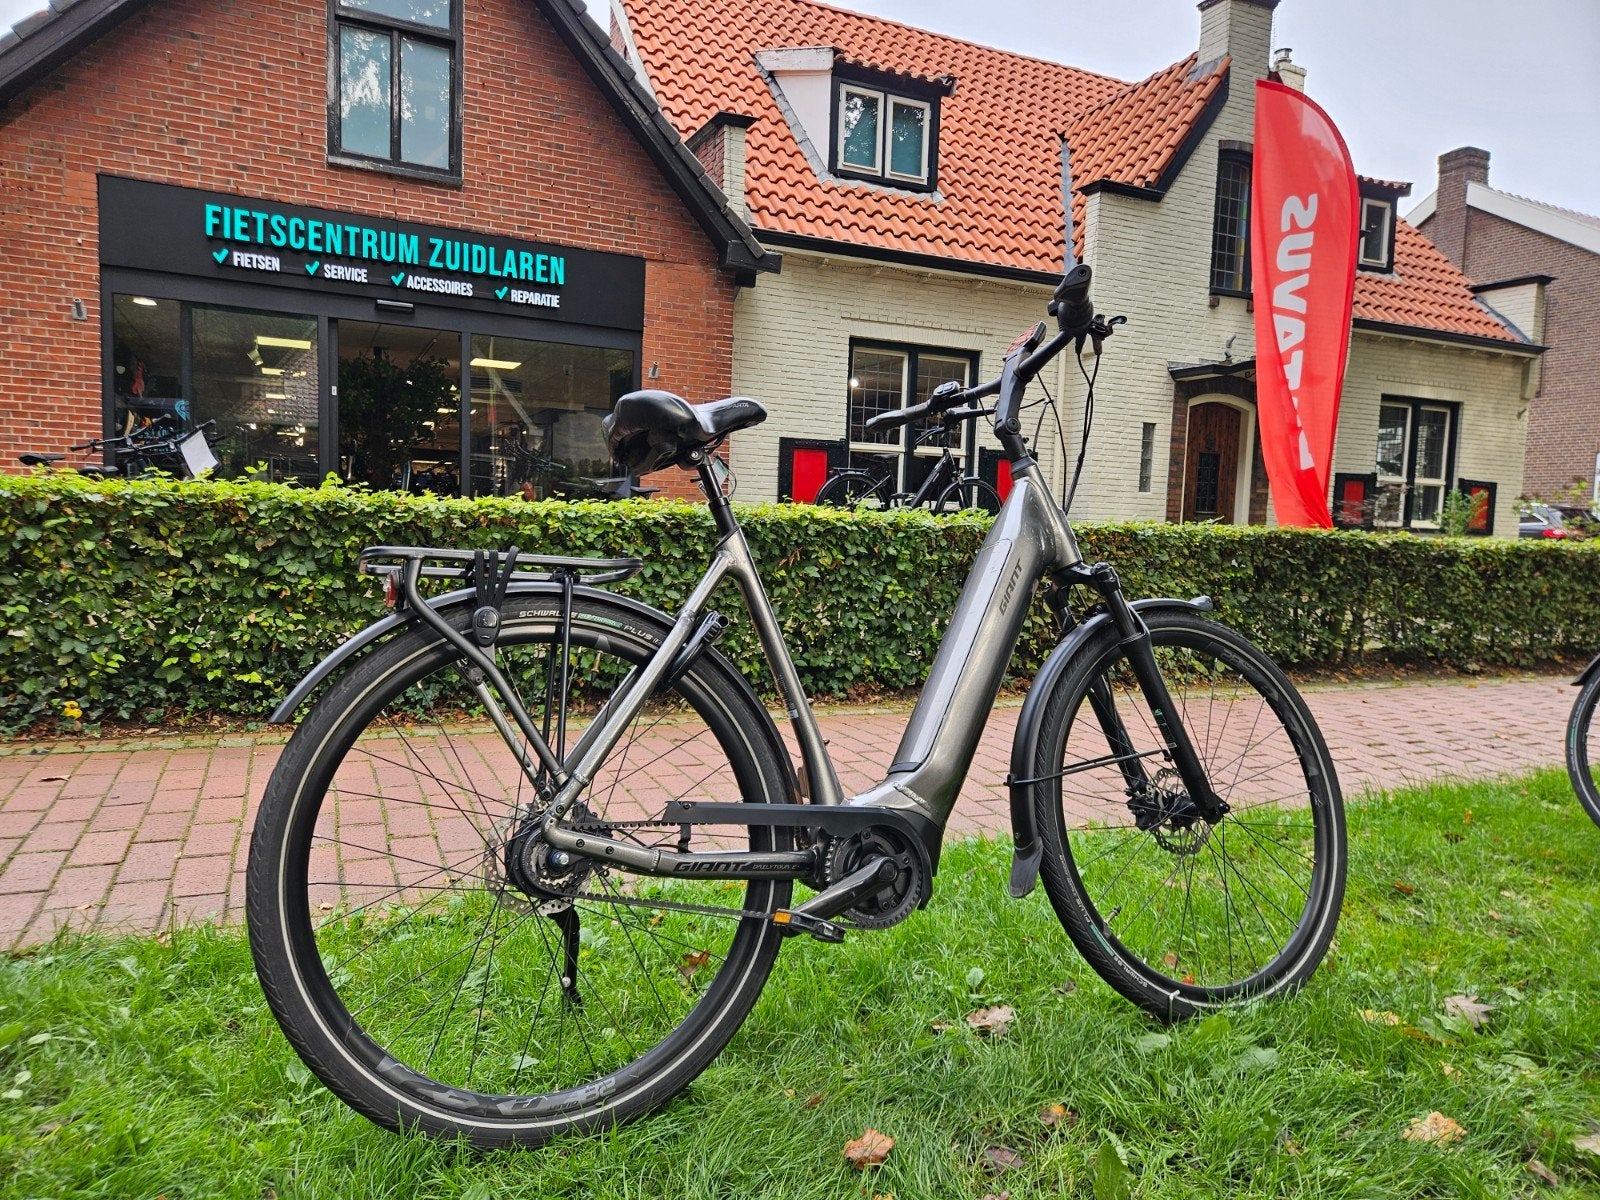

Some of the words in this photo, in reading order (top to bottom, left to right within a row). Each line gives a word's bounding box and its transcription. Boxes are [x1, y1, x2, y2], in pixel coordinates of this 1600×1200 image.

[204, 203, 420, 265] FIETSCENTRUM
[428, 237, 566, 286] ZUIDLAREN
[232, 250, 281, 272] FIETSEN
[323, 263, 369, 284] SERVICE
[406, 274, 474, 298] ACCESSOIRES
[510, 288, 561, 309] REPARATIE
[999, 557, 1023, 616] GIANT
[518, 610, 577, 619] SCHWALE
[623, 625, 654, 641] PLUS
[672, 861, 751, 872] GIANT
